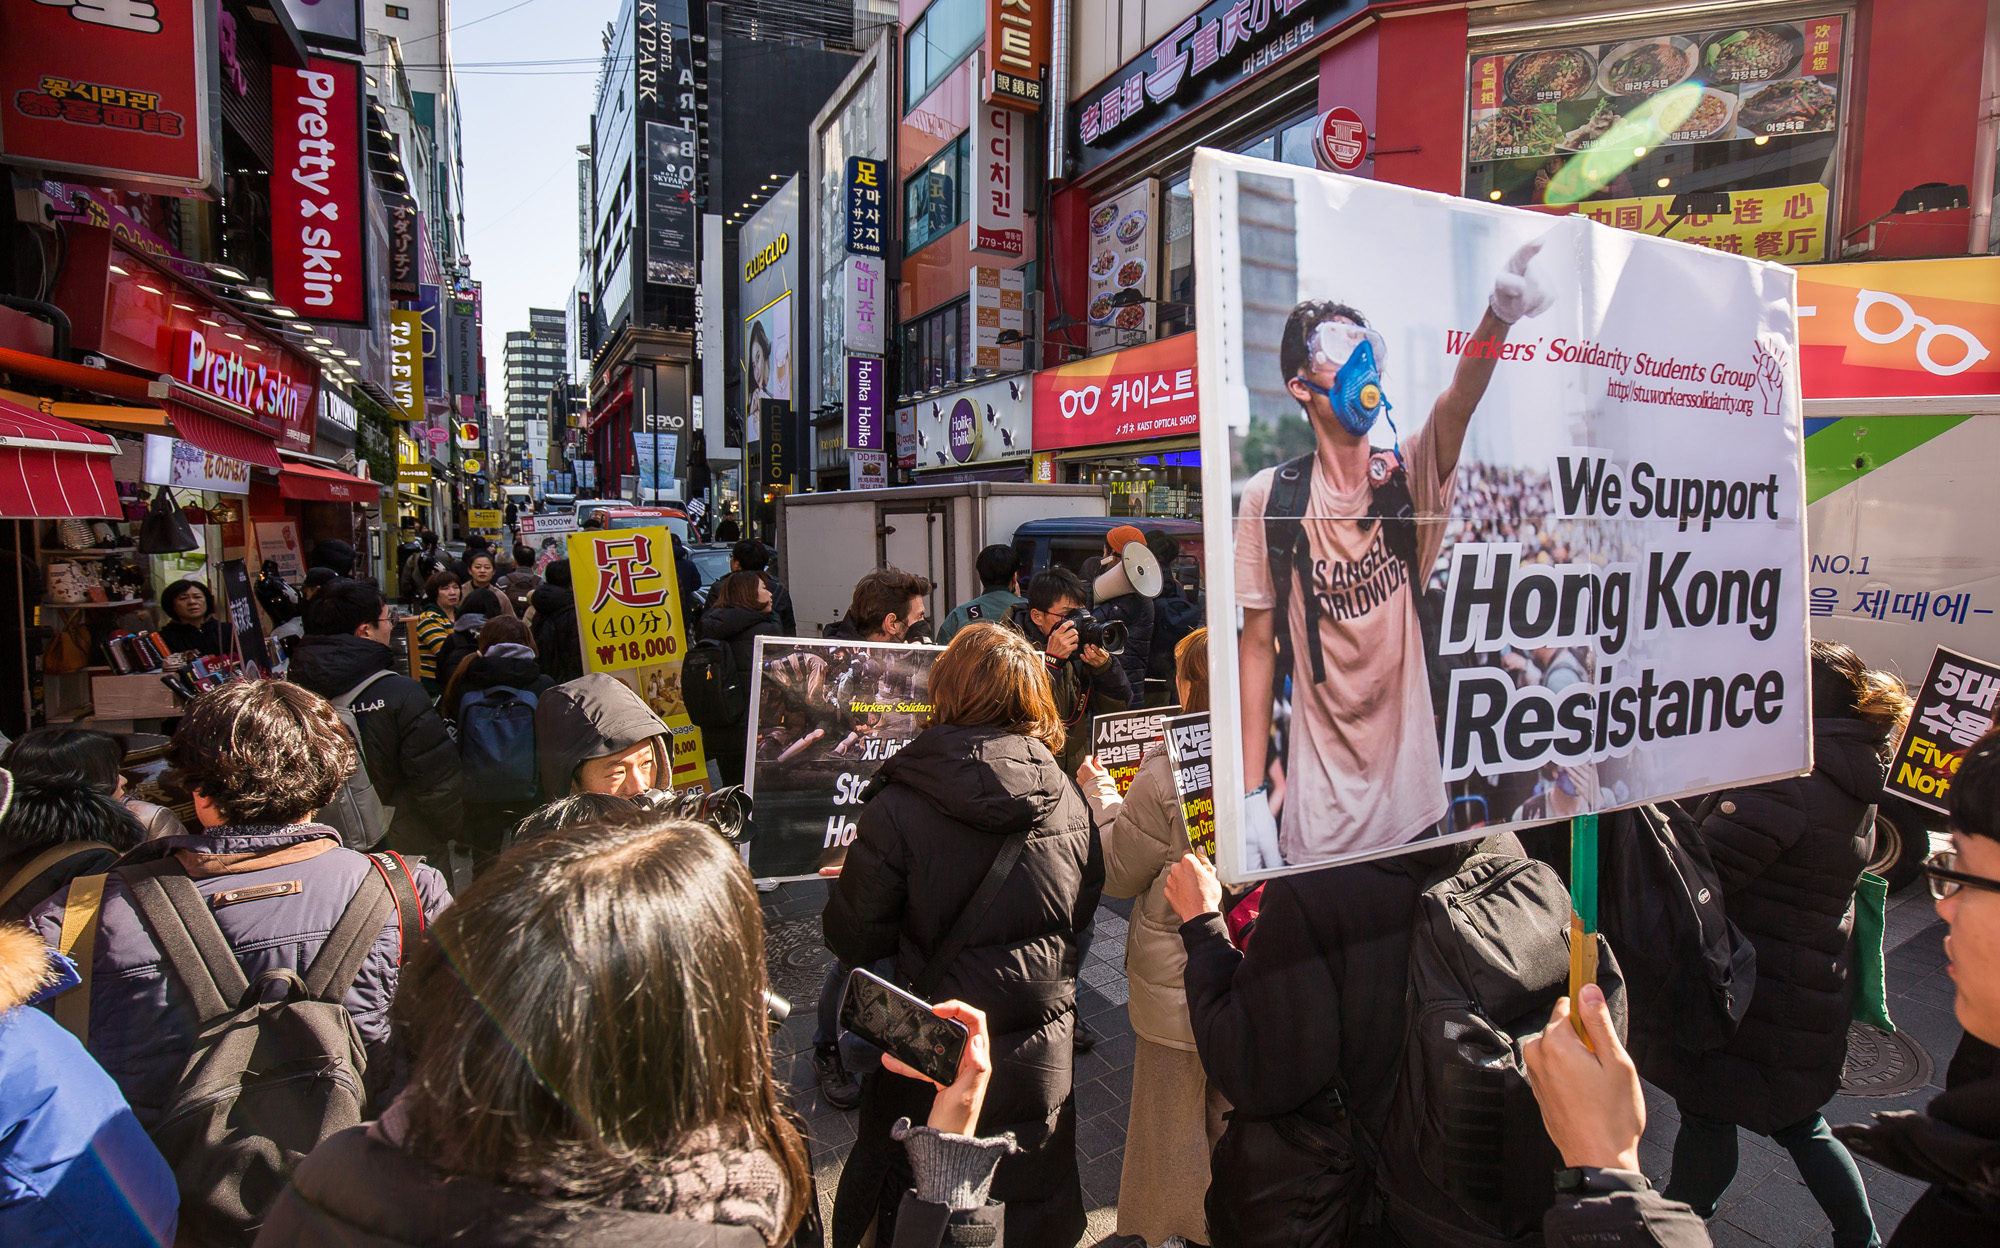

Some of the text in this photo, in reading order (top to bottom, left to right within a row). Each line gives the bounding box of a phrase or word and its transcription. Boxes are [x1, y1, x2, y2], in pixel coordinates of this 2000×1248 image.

[660, 20, 672, 73] HOTEL
[1191, 0, 1305, 77] 重庆小
[1813, 24, 1831, 71] 欢迎您
[997, 74, 1039, 99] 眼鏡院
[1079, 70, 1144, 146] 老扁担
[291, 69, 342, 307] Pretty skin
[855, 161, 878, 187] 足
[990, 110, 1011, 218] 디디치킨
[852, 188, 864, 240] マッサージ
[866, 189, 880, 243] 마사지
[745, 233, 788, 282] CLUBCLIO
[853, 242, 880, 252] 755-4480
[979, 236, 1022, 251] 779-1421
[188, 330, 299, 421] Pretty skin
[391, 321, 413, 408] TALENT
[1446, 330, 1757, 392] Workers' Solidarity Students Group
[858, 361, 872, 447] Holika Holika
[1111, 369, 1194, 412] 카이스트
[646, 414, 685, 428] SPAO
[771, 405, 782, 478] CLUBCLIO
[952, 414, 972, 431] Holika
[952, 432, 970, 447] Holik
[1115, 422, 1136, 436] メガネ
[1137, 414, 1197, 431] KAIST OPTICAL SHOP
[1037, 460, 1052, 481] 遠
[1556, 456, 1779, 532] We Support
[590, 535, 669, 613] 足
[1811, 554, 1870, 575] NO.1
[591, 610, 673, 640] (40分)
[1449, 550, 1782, 655] Hong Kong
[851, 702, 895, 713] Workers'
[1451, 667, 1785, 771] Resistance
[861, 738, 880, 760] Xi
[1897, 763, 1950, 798] Not
